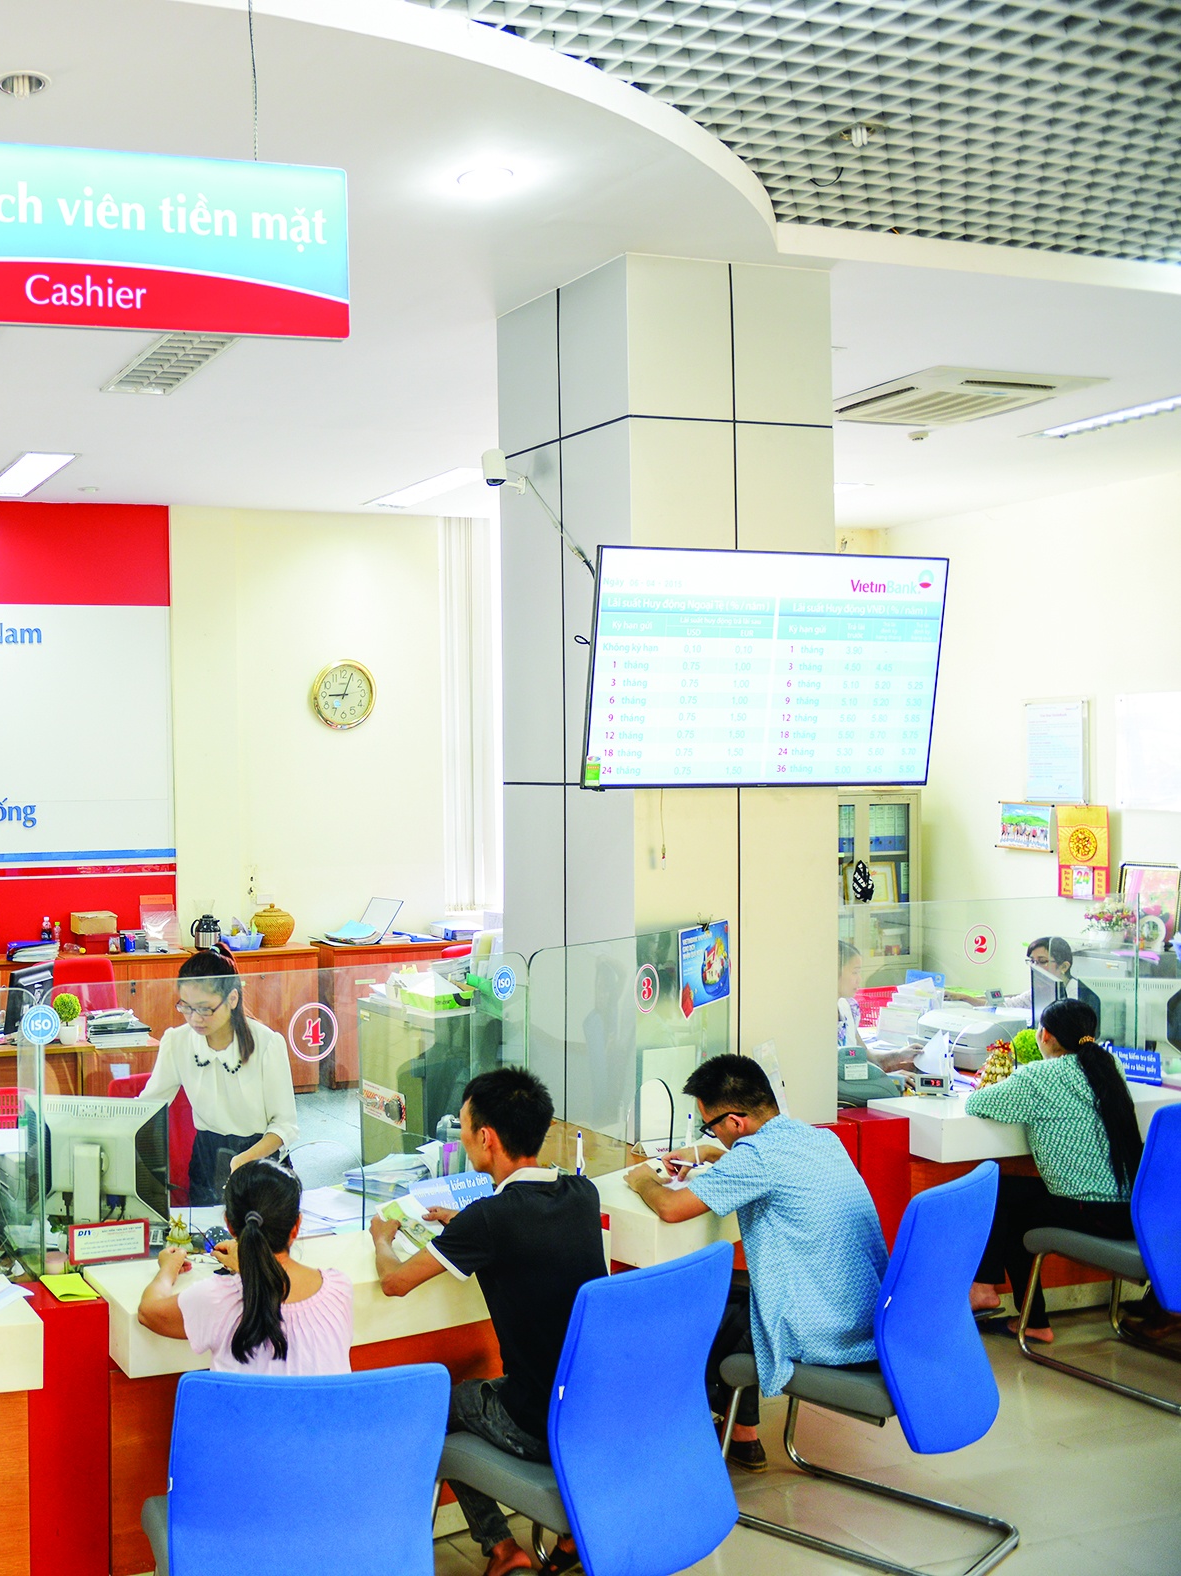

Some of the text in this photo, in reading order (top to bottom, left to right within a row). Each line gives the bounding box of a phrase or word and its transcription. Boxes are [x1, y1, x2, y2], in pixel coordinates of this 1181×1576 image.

[58, 186, 146, 231] viên
[159, 193, 237, 238] tiền
[251, 207, 327, 252] mặt
[25, 274, 147, 309] Cashier
[850, 578, 918, 595] VietinBank
[800, 645, 824, 656] tháng
[613, 660, 616, 668] 1
[624, 660, 649, 672] tháng
[789, 662, 793, 670] 3
[799, 662, 822, 673] tháng
[611, 678, 616, 687] 3
[622, 678, 648, 689] tháng
[798, 680, 821, 690] tháng
[610, 696, 614, 704] 6
[621, 696, 646, 707] tháng
[796, 697, 820, 707] tháng
[608, 714, 614, 722] 9
[620, 714, 646, 724] tháng
[782, 714, 791, 722] 12
[794, 714, 818, 724] tháng
[606, 731, 614, 740] 12
[618, 731, 644, 742] tháng
[780, 731, 790, 739] 18
[792, 730, 816, 740] tháng
[604, 748, 614, 757] 18
[617, 748, 642, 759] tháng
[791, 748, 815, 758] tháng
[602, 766, 612, 774] 24
[616, 766, 641, 776] tháng
[776, 765, 786, 773] 36
[790, 764, 813, 774] tháng
[974, 934, 988, 954] 2
[498, 978, 511, 989] ISO
[642, 976, 652, 1000] 3
[30, 1020, 51, 1031] ISO
[302, 1018, 326, 1046] 4
